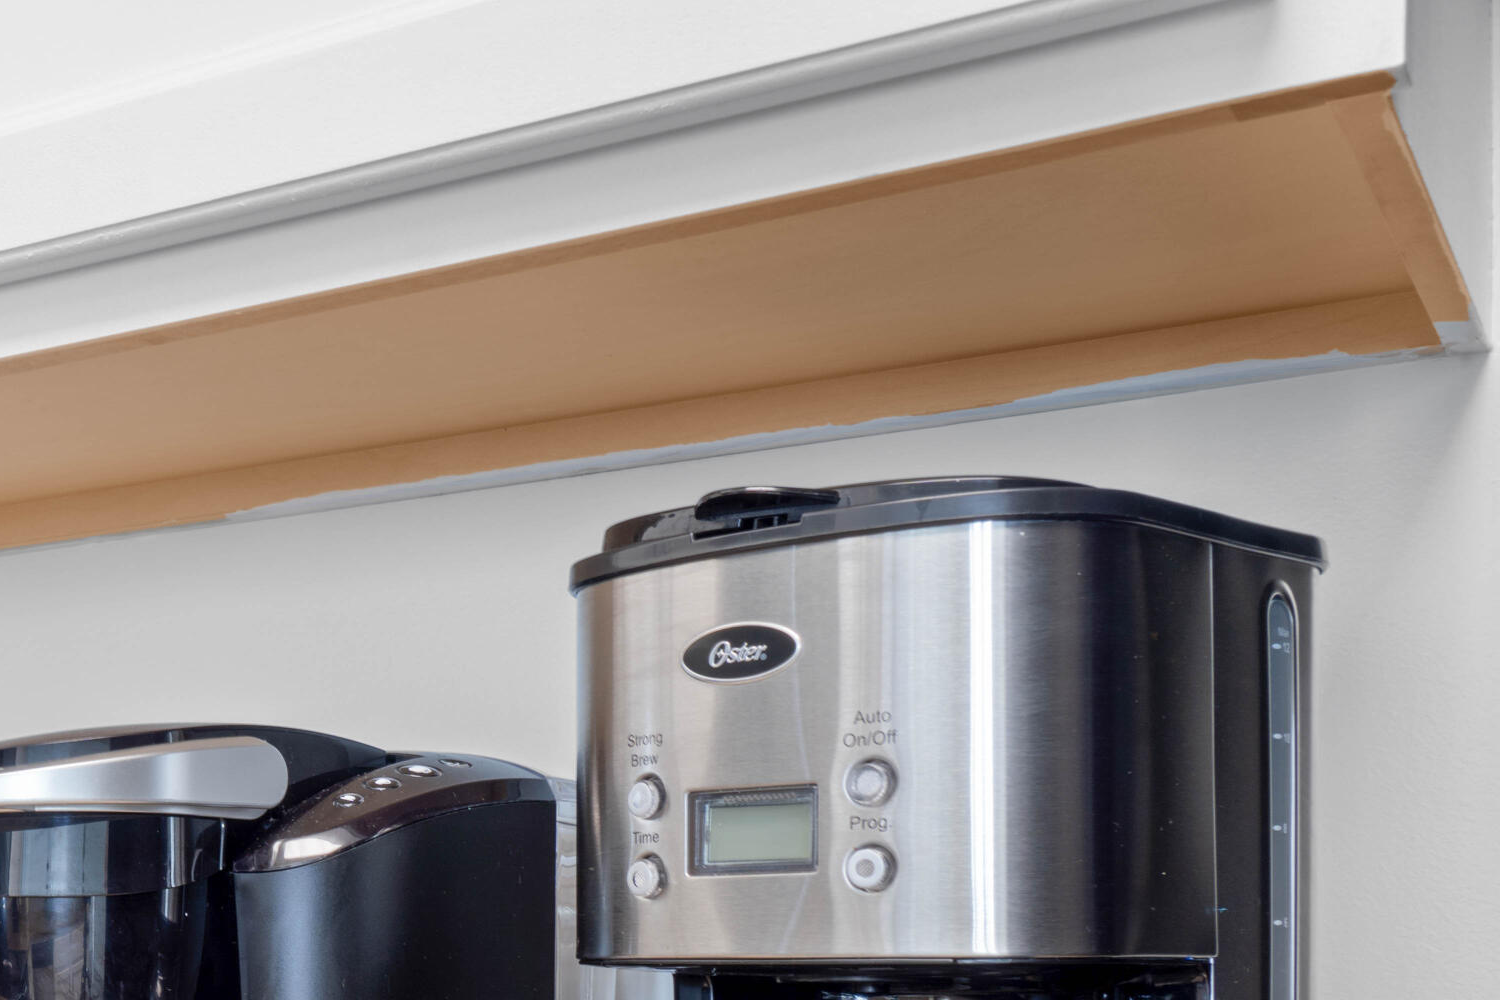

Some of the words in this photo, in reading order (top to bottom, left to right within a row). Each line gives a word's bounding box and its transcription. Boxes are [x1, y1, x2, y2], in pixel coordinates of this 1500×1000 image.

[853, 709, 892, 725] Auto
[627, 731, 663, 750] Strong
[843, 729, 898, 748] On/Off
[630, 754, 658, 768] Brew
[632, 831, 659, 844] Time
